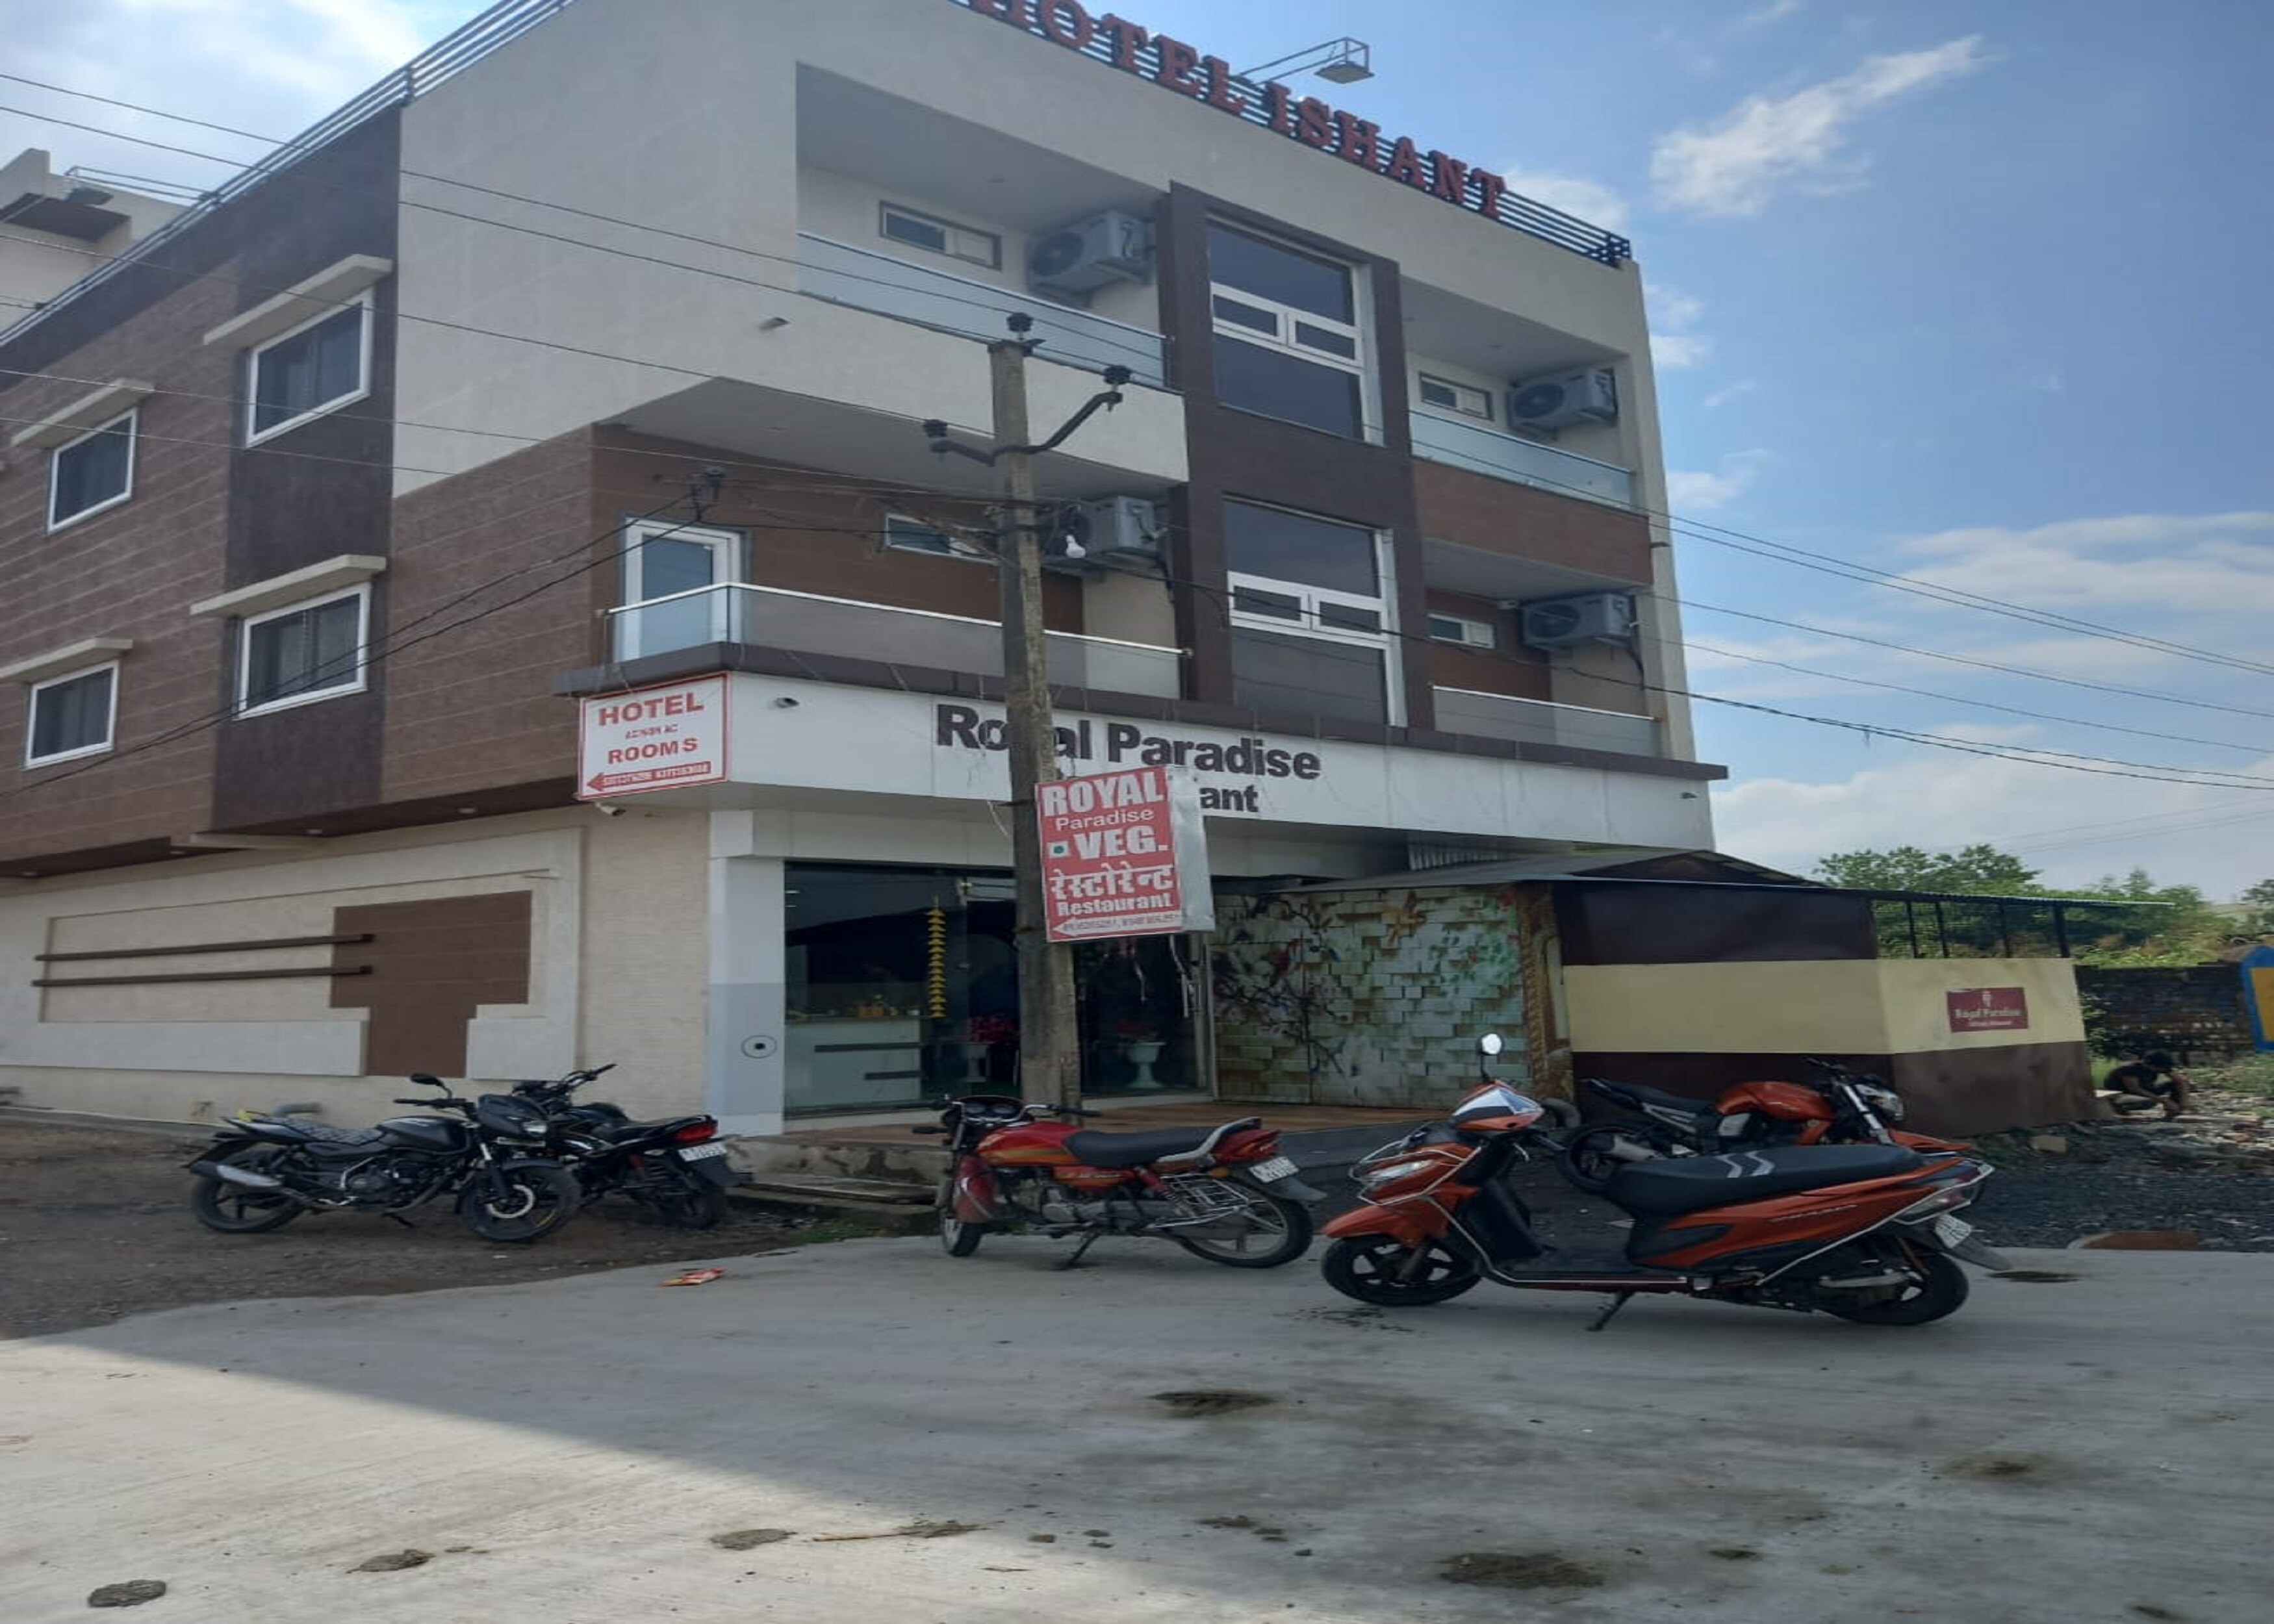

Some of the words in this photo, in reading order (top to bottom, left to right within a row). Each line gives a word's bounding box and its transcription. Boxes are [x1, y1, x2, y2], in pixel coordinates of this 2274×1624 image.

[1266, 81, 1504, 220] ISHANT
[598, 692, 704, 726] HOTEL
[607, 737, 698, 765] ROOMS
[938, 704, 1093, 760] Roal
[1107, 722, 1322, 780] Paradise
[1042, 772, 1164, 817] ROYAL
[1056, 808, 1155, 831] Paradise
[1073, 825, 1168, 860] VEG.
[1056, 893, 1173, 917] Restaurant
